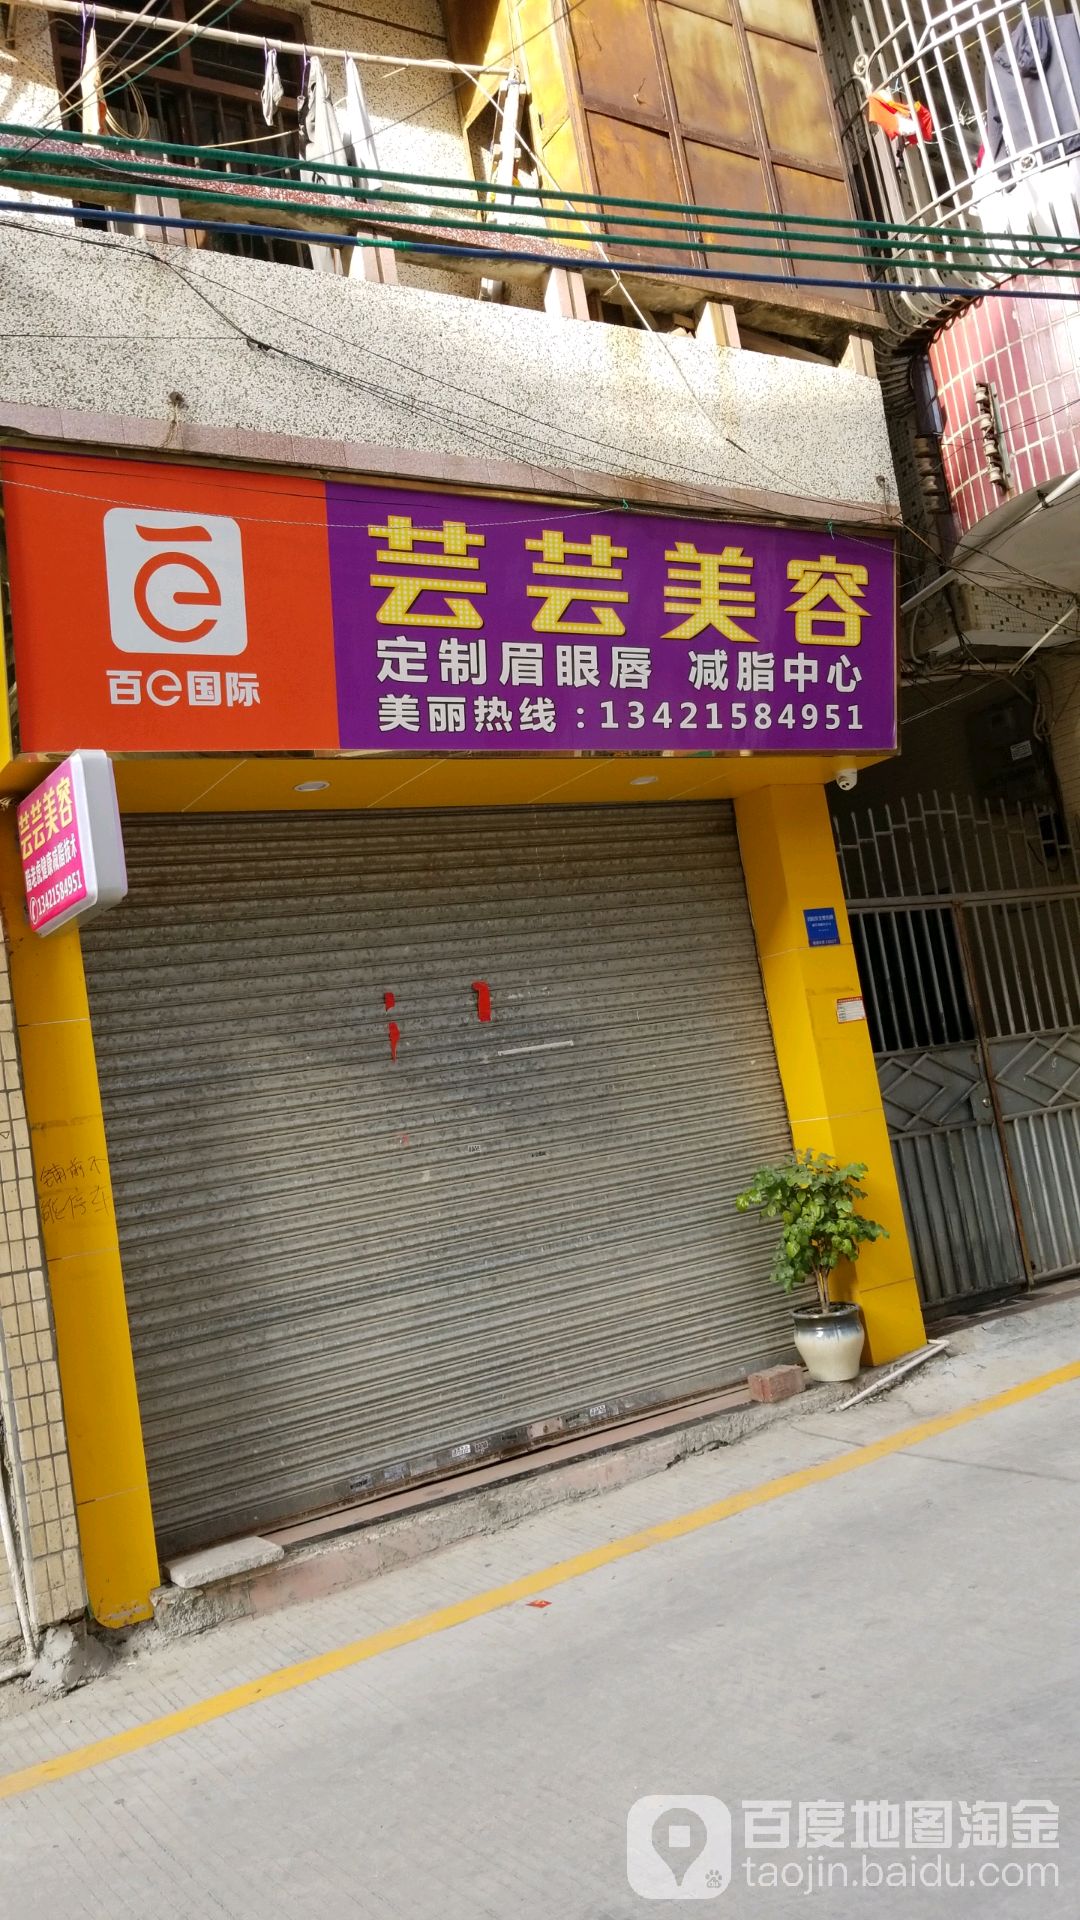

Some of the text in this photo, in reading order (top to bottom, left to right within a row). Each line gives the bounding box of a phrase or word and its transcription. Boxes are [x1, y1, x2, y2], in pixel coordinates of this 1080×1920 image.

[368, 515, 872, 647] 芸芸美容
[106, 669, 261, 707] 百e国际
[376, 636, 862, 693] 定制眉眼唇 减脂中心
[18, 777, 73, 860] 芸芸美容
[36, 869, 83, 915] 13421584951
